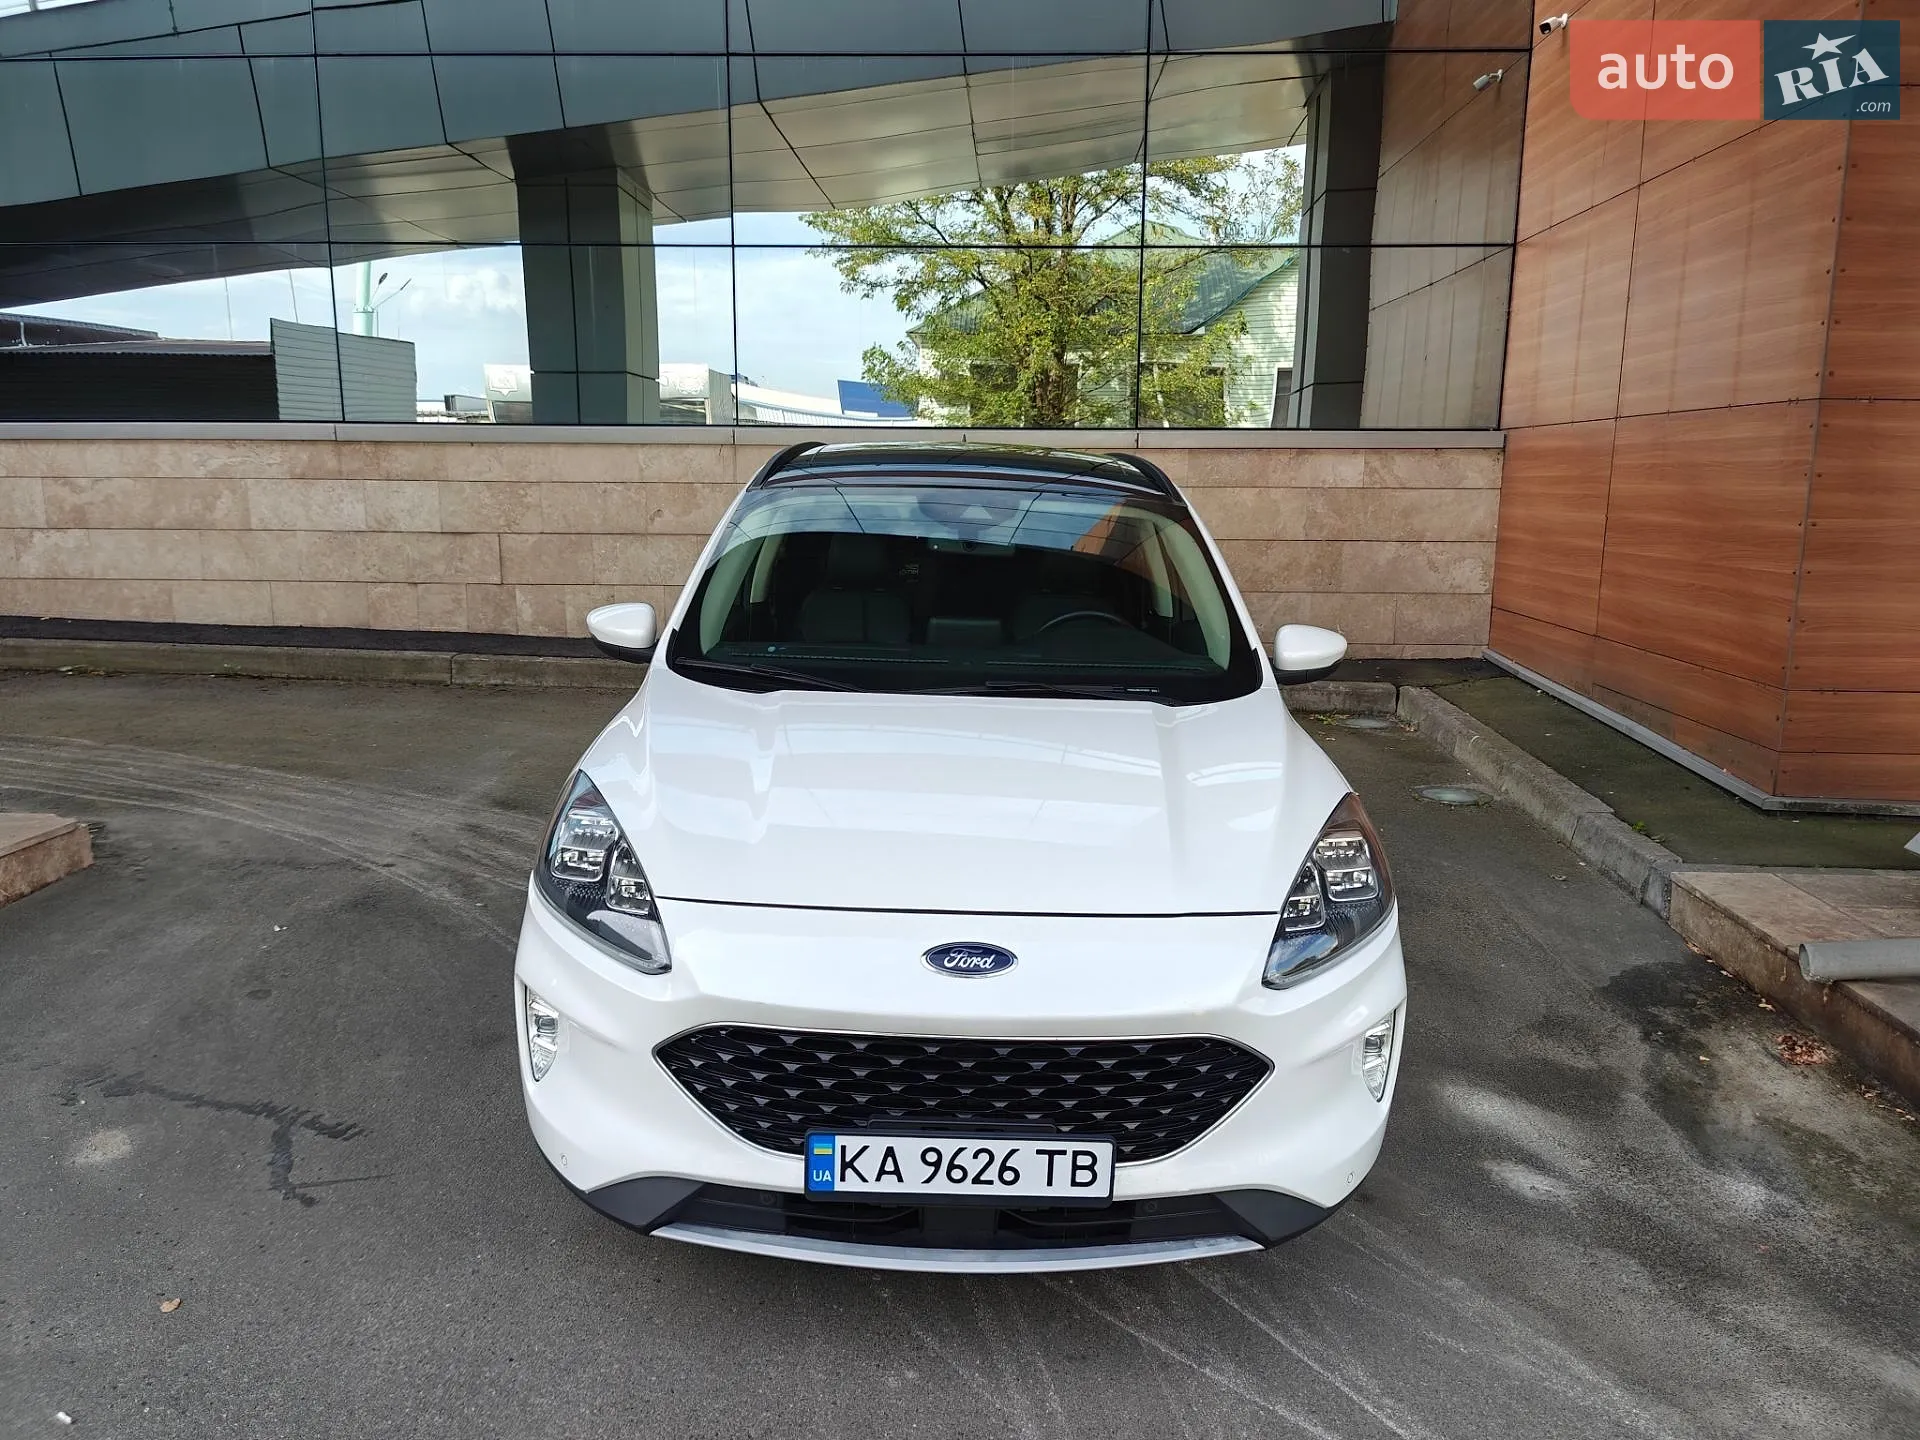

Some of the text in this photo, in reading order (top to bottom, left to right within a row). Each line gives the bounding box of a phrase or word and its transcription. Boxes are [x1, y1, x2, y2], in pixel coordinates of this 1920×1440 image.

[943, 947, 995, 969] Ford
[813, 1170, 832, 1182] UA
[839, 1145, 1098, 1188] KA 9626 TB
